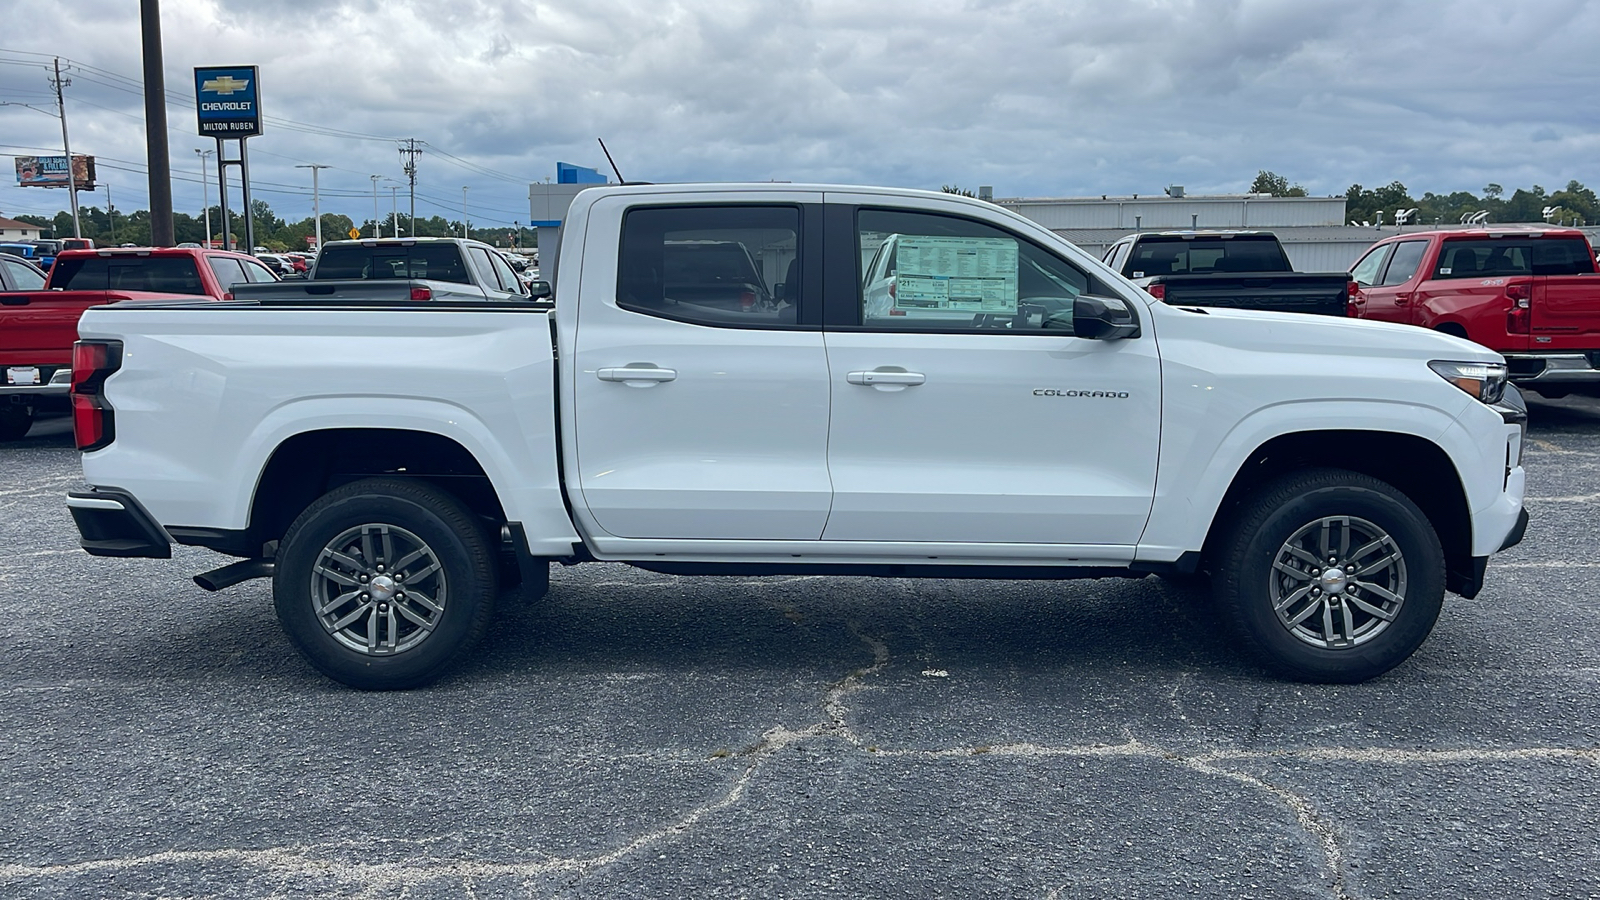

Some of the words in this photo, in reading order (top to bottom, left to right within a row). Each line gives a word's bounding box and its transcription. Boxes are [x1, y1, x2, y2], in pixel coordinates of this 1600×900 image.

[201, 102, 251, 111] CHEVROLET
[203, 122, 228, 131] MILTON
[230, 122, 254, 130] RUBEN
[1032, 388, 1129, 399] COLORADO
